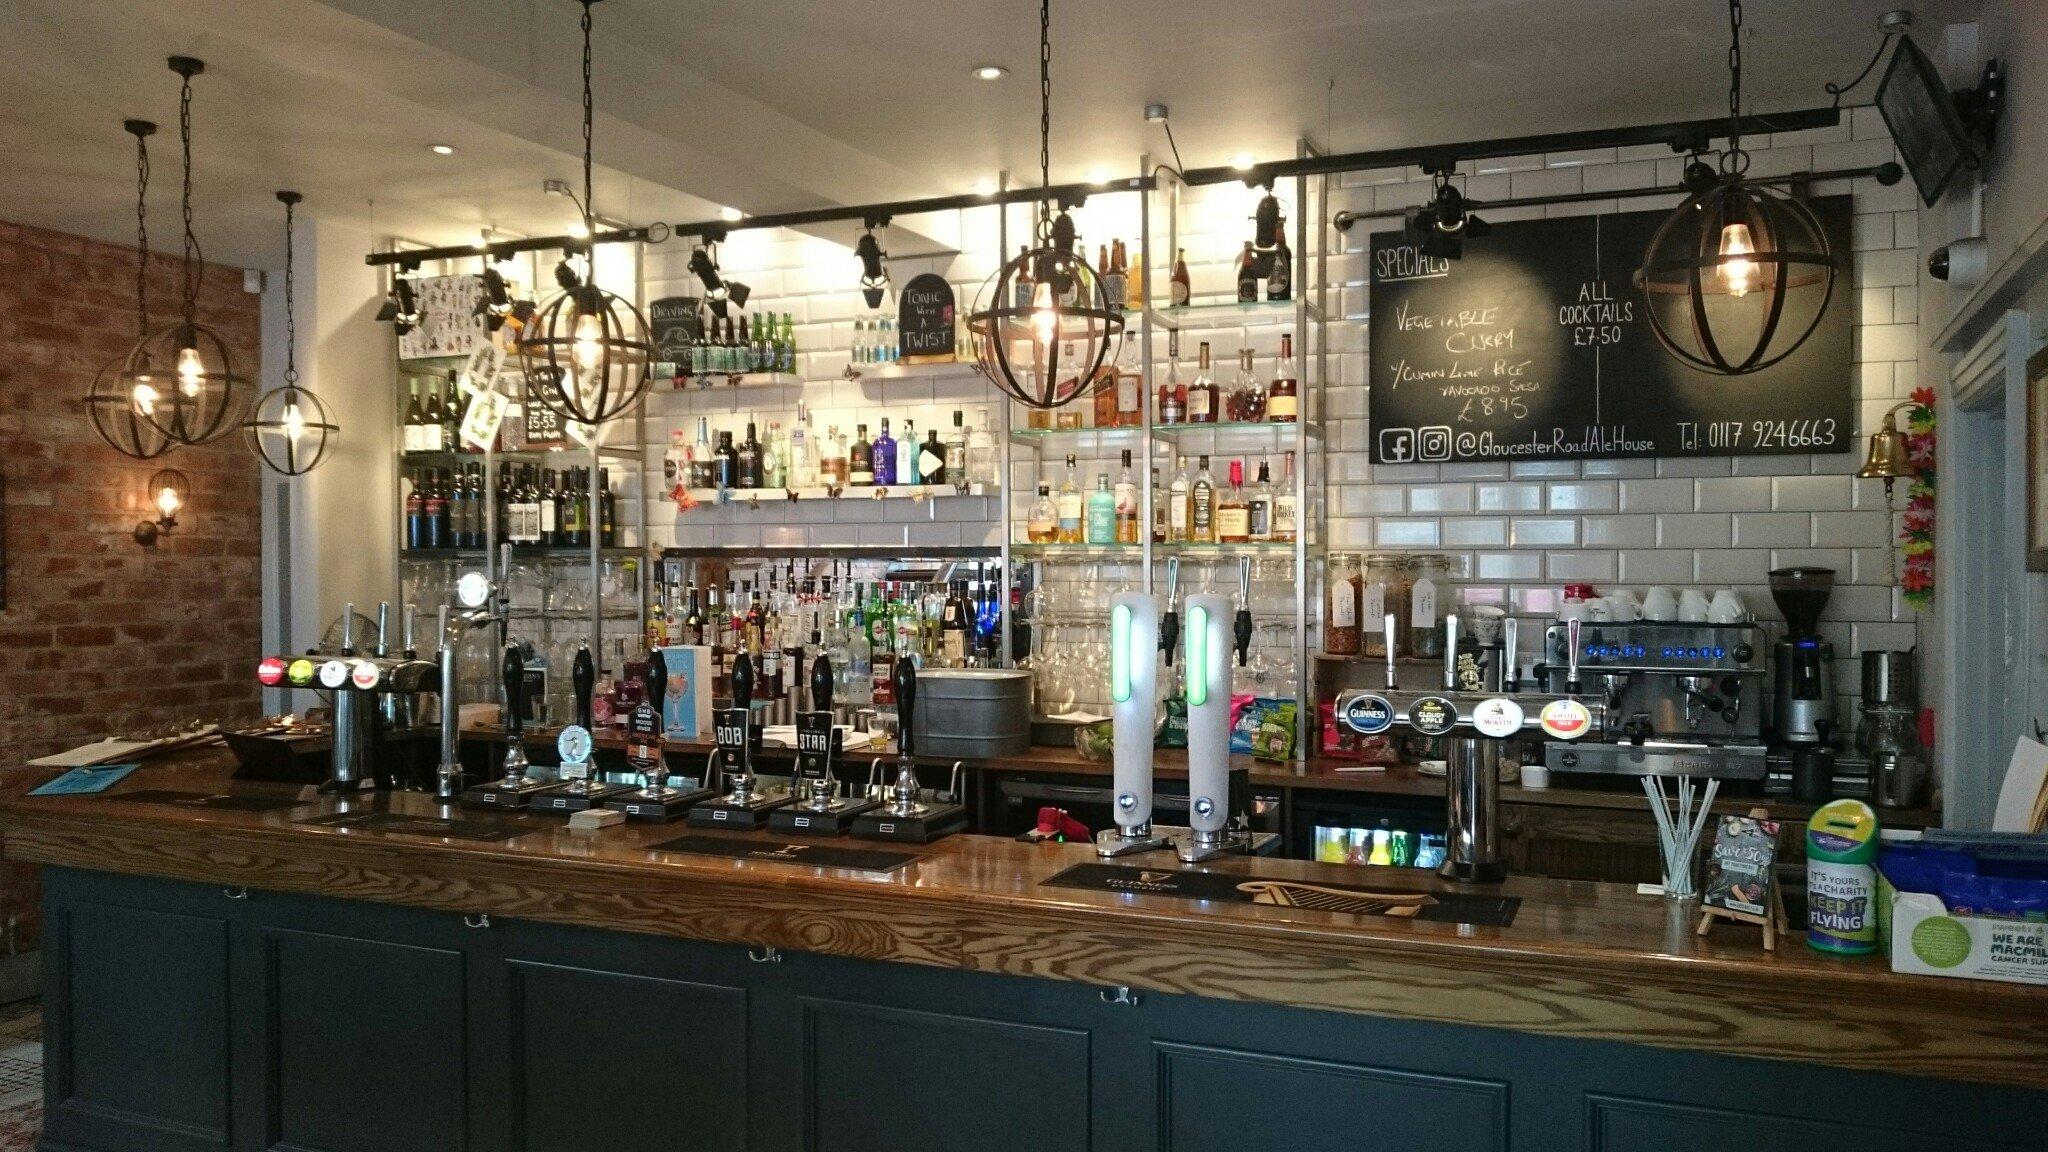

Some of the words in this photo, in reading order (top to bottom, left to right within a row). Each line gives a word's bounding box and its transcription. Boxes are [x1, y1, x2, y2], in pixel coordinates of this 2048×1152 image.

[1377, 246, 1449, 277] SPECIALS
[905, 289, 940, 304] TONIC
[1579, 281, 1613, 301] ALL
[1559, 302, 1633, 325] COCKTAILS
[920, 317, 927, 329] A
[903, 331, 950, 348] TWIST
[1446, 329, 1514, 353] CURRY
[1456, 425, 1655, 457] @GloucesterRoadAleHouse
[1709, 422, 1743, 448] 0117
[1753, 418, 1836, 448] 9246663
[1350, 708, 1386, 719] GUINNESS
[1418, 711, 1445, 719] CLOUDY
[717, 725, 743, 746] BOB
[799, 733, 827, 751] STAR
[1811, 870, 1827, 882] IT'S
[1829, 875, 1860, 885] YOURS
[1824, 884, 1867, 896] CHARITY
[1811, 910, 1862, 930] FLYING
[1992, 934, 2013, 943] WE
[2016, 935, 2043, 946] ARE
[1991, 955, 2028, 964] CANCER
